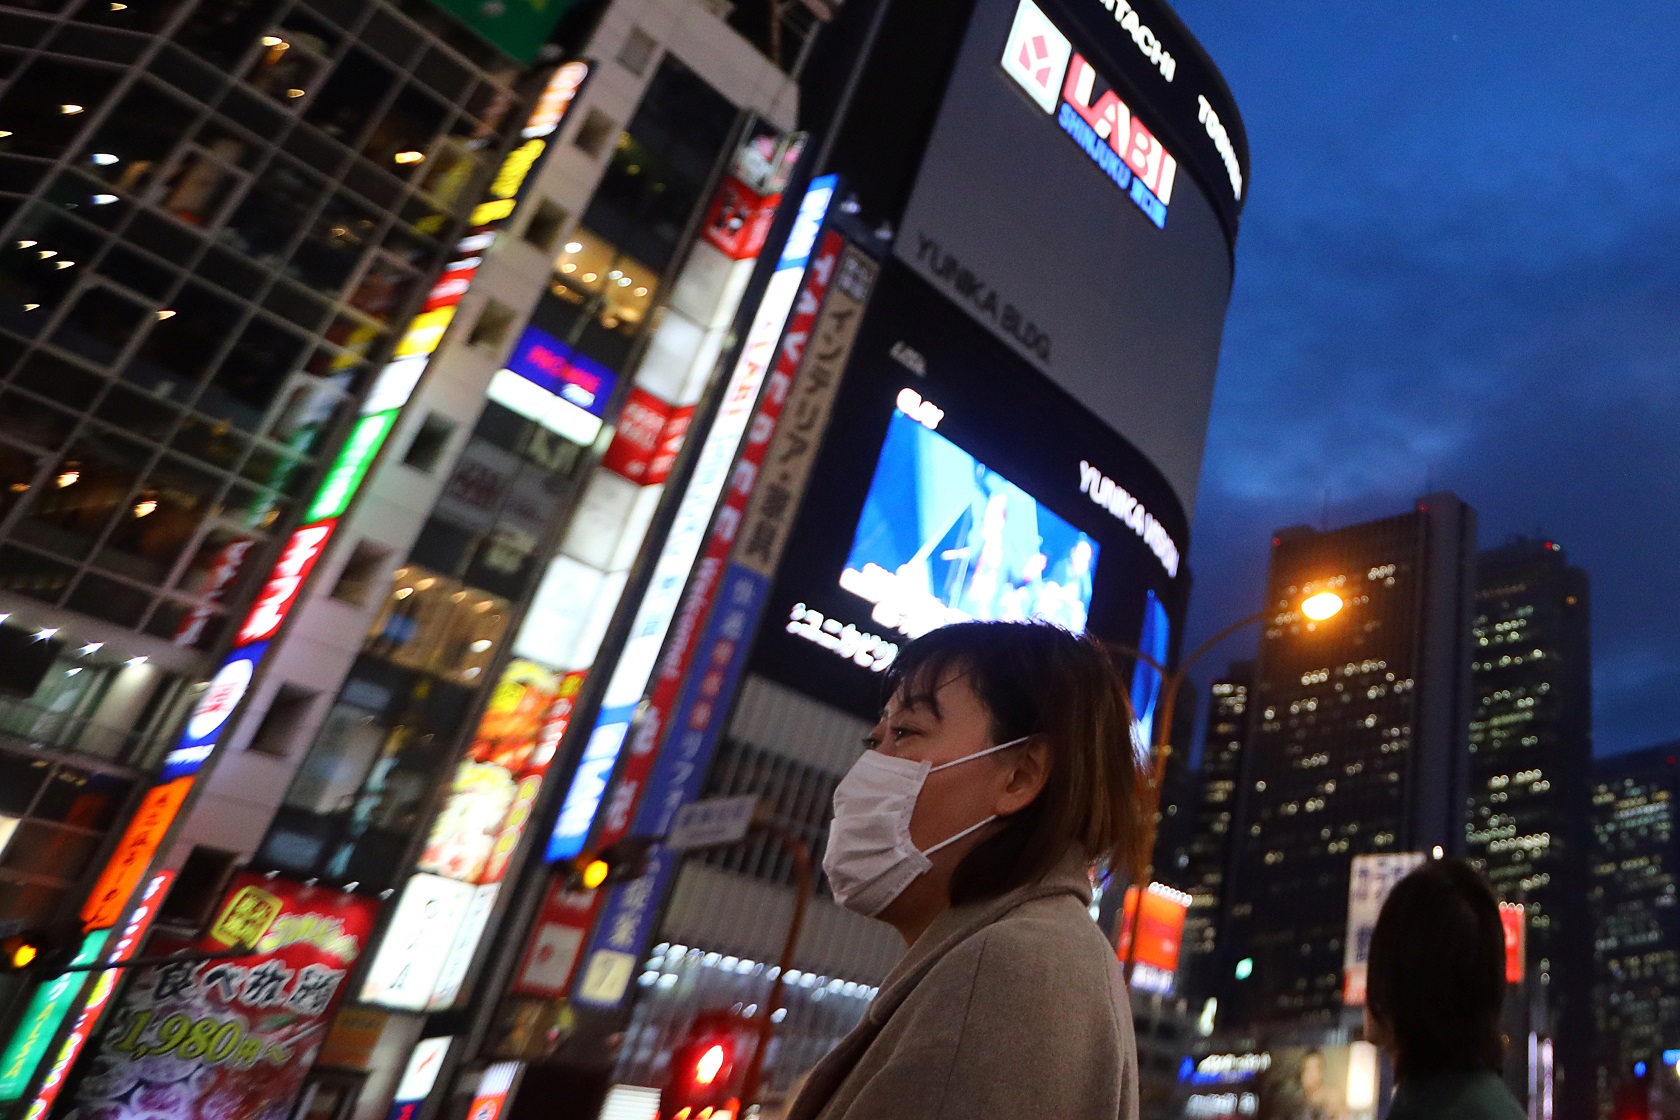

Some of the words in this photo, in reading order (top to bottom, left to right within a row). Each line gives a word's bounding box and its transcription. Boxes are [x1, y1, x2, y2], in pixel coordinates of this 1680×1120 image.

[1057, 102, 1131, 190] SHINJUKU
[1061, 52, 1178, 207] LABI
[915, 232, 999, 325] YUNIKA
[1079, 459, 1145, 537] YUNIKA
